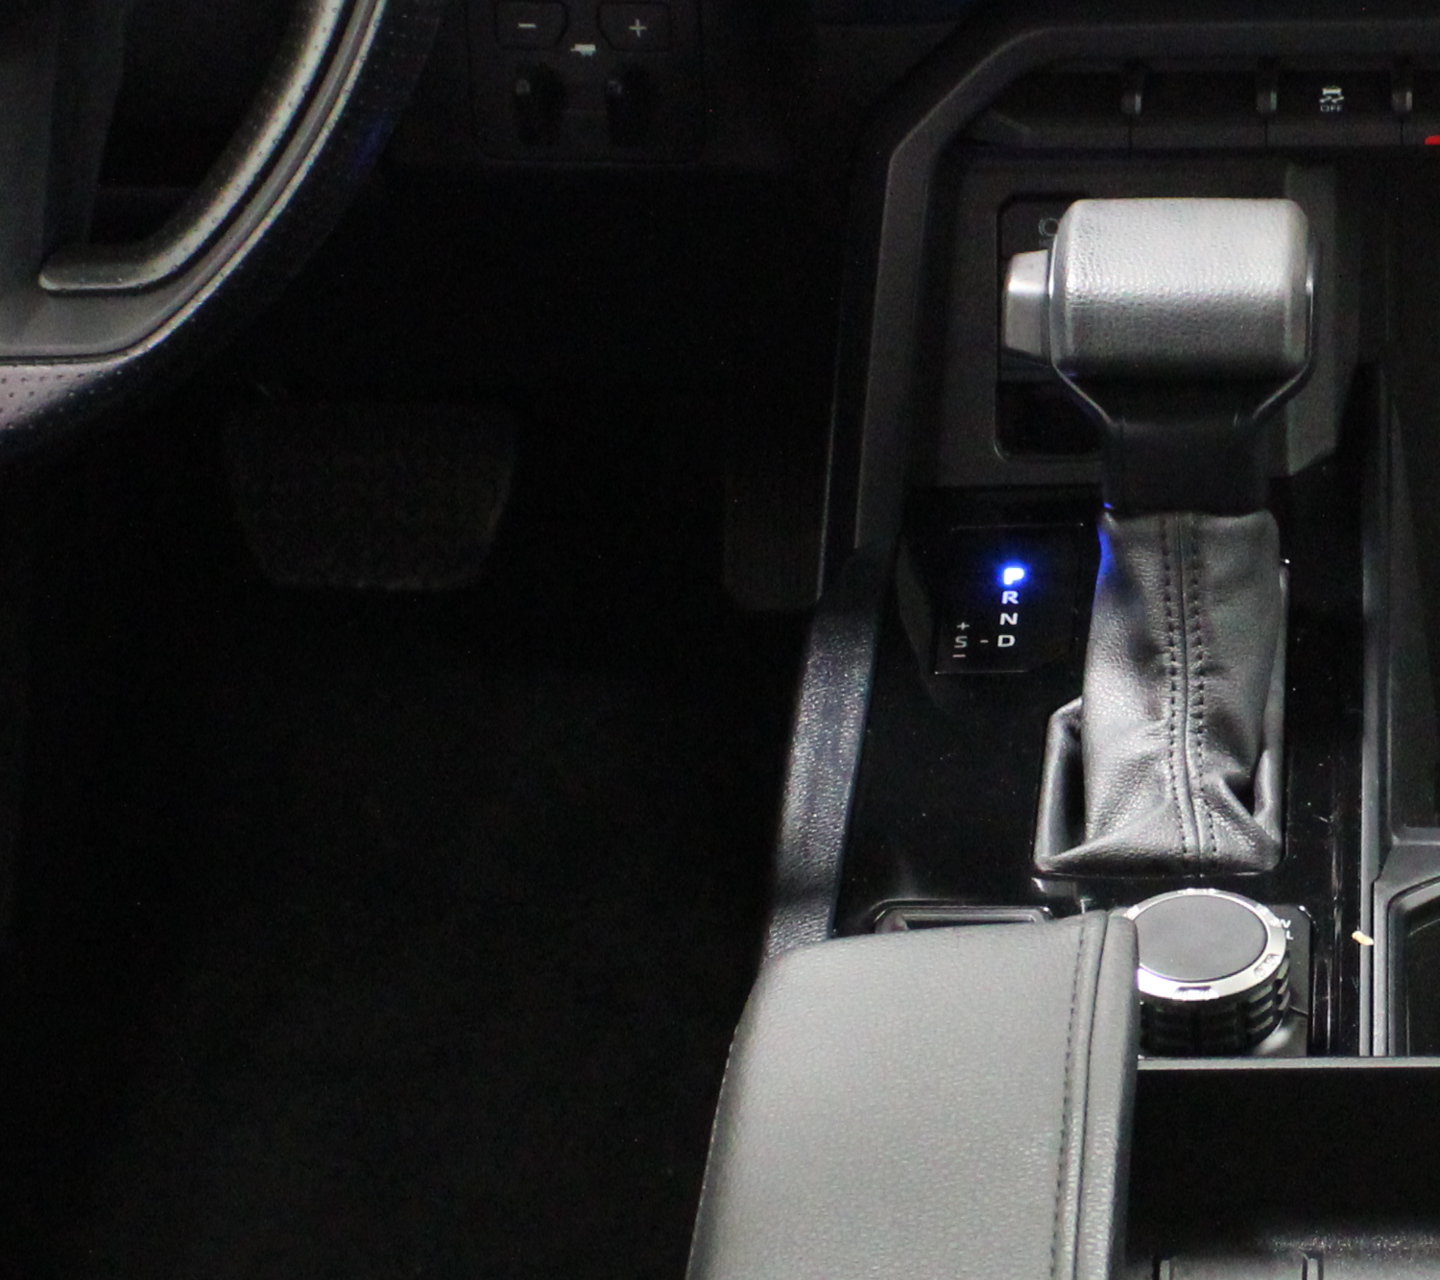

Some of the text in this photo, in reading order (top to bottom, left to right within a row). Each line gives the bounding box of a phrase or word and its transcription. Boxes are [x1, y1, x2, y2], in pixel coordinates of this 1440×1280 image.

[1003, 567, 1025, 585] P
[1001, 590, 1019, 605] R
[999, 611, 1018, 626] N
[953, 633, 1016, 649] S D
